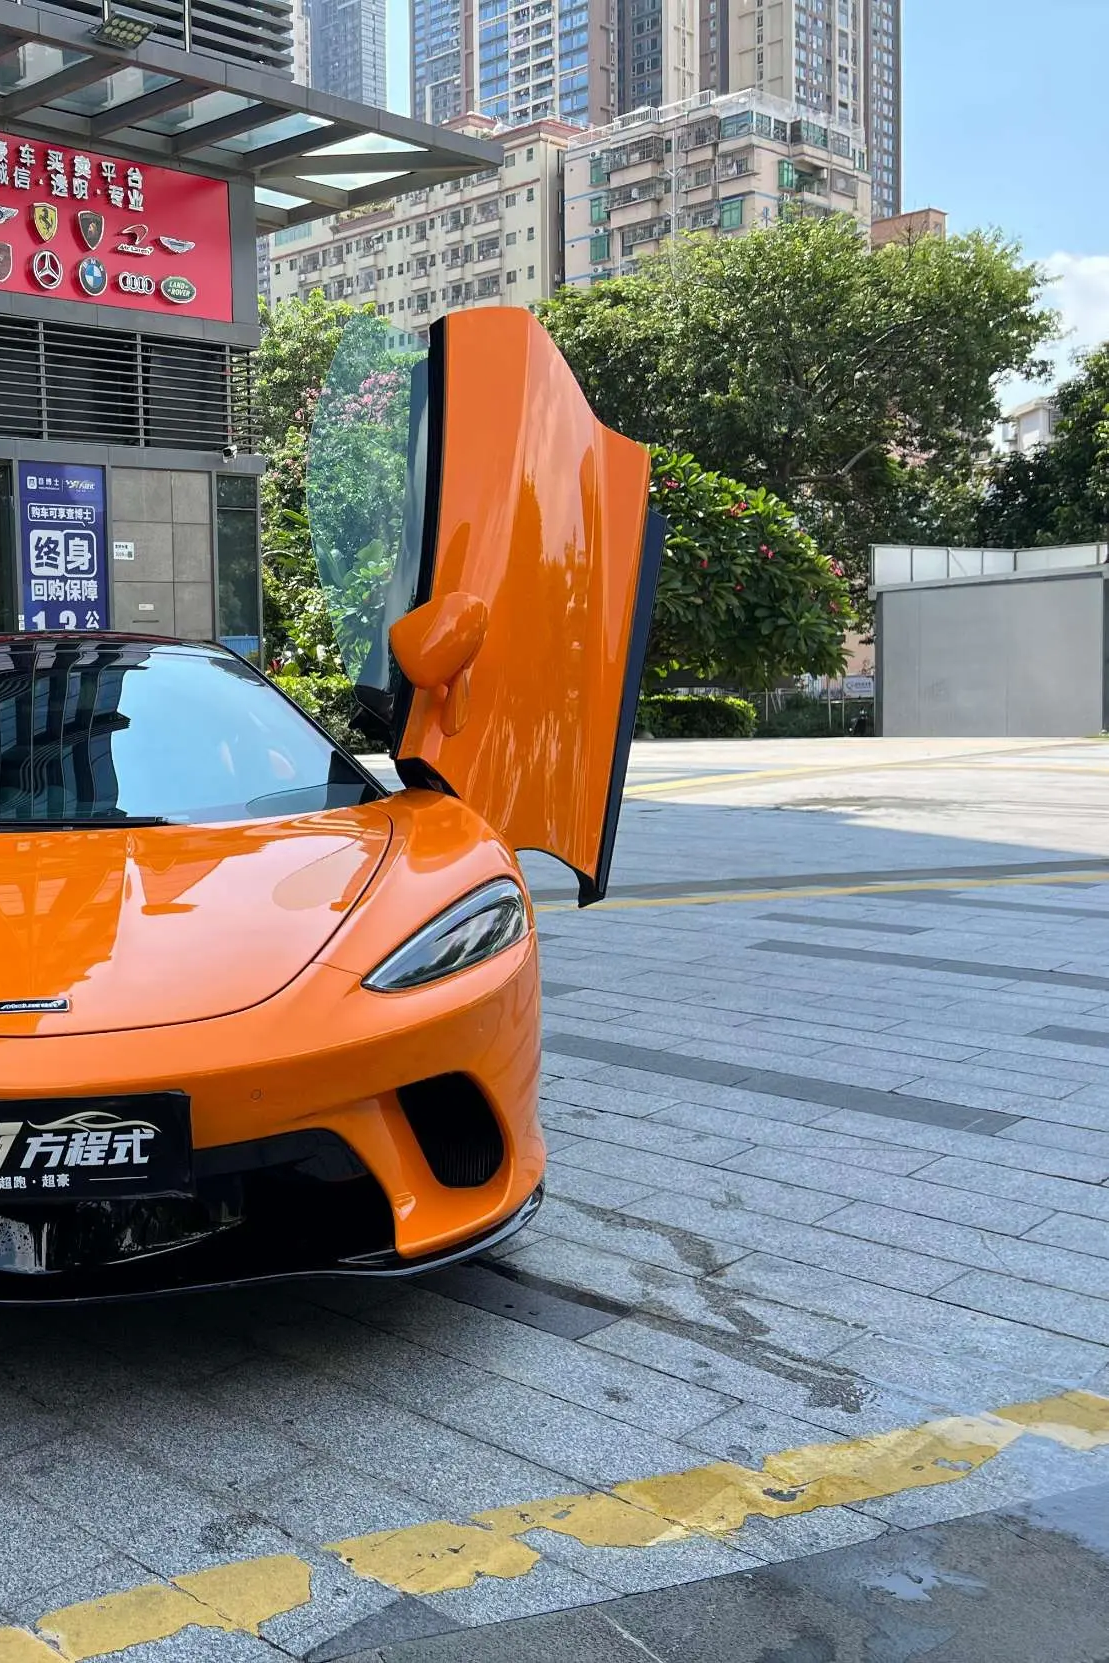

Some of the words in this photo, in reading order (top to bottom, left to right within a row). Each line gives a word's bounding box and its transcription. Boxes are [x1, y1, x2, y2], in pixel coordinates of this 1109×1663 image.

[169, 281, 185, 289] LAND
[170, 288, 191, 297] ROVER
[31, 506, 92, 520] 购车可享查博士
[34, 536, 91, 571] 终身
[31, 579, 98, 602] 回购保障
[19, 1128, 155, 1169] 方程式
